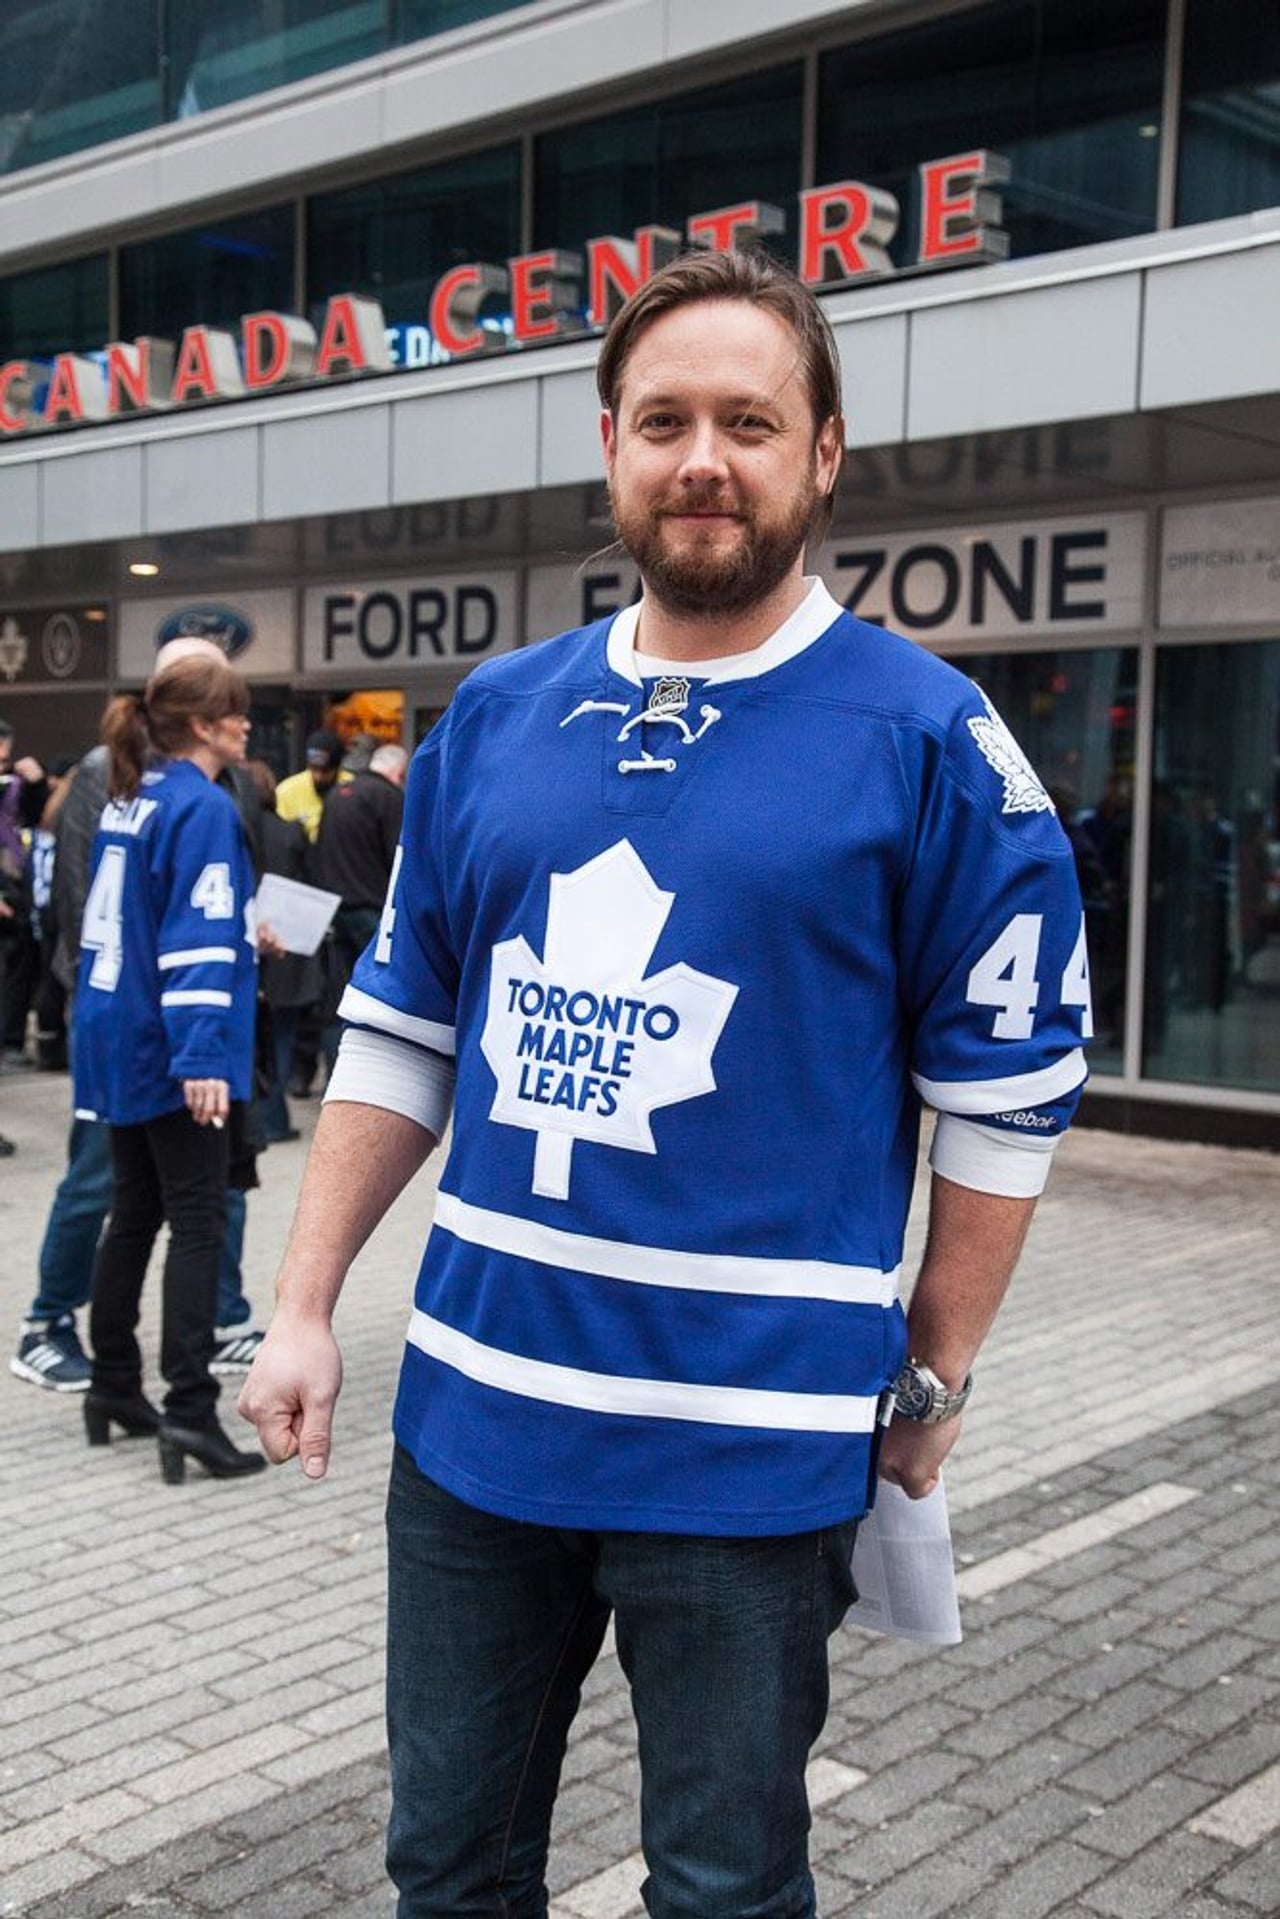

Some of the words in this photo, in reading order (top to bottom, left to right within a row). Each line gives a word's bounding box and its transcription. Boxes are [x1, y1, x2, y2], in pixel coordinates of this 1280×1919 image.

[0, 294, 370, 433] CANADA
[430, 149, 988, 357] CENTRE
[323, 584, 498, 661] FORD
[582, 573, 644, 626] F
[835, 530, 1108, 630] ZONE
[80, 844, 127, 992] 4
[190, 862, 235, 920] 4
[966, 910, 1094, 1040] 44
[508, 978, 681, 1041] TORONTO
[516, 1022, 635, 1078] MAPLE
[517, 1063, 621, 1117] LEAFS
[994, 1110, 1057, 1128] eebo
